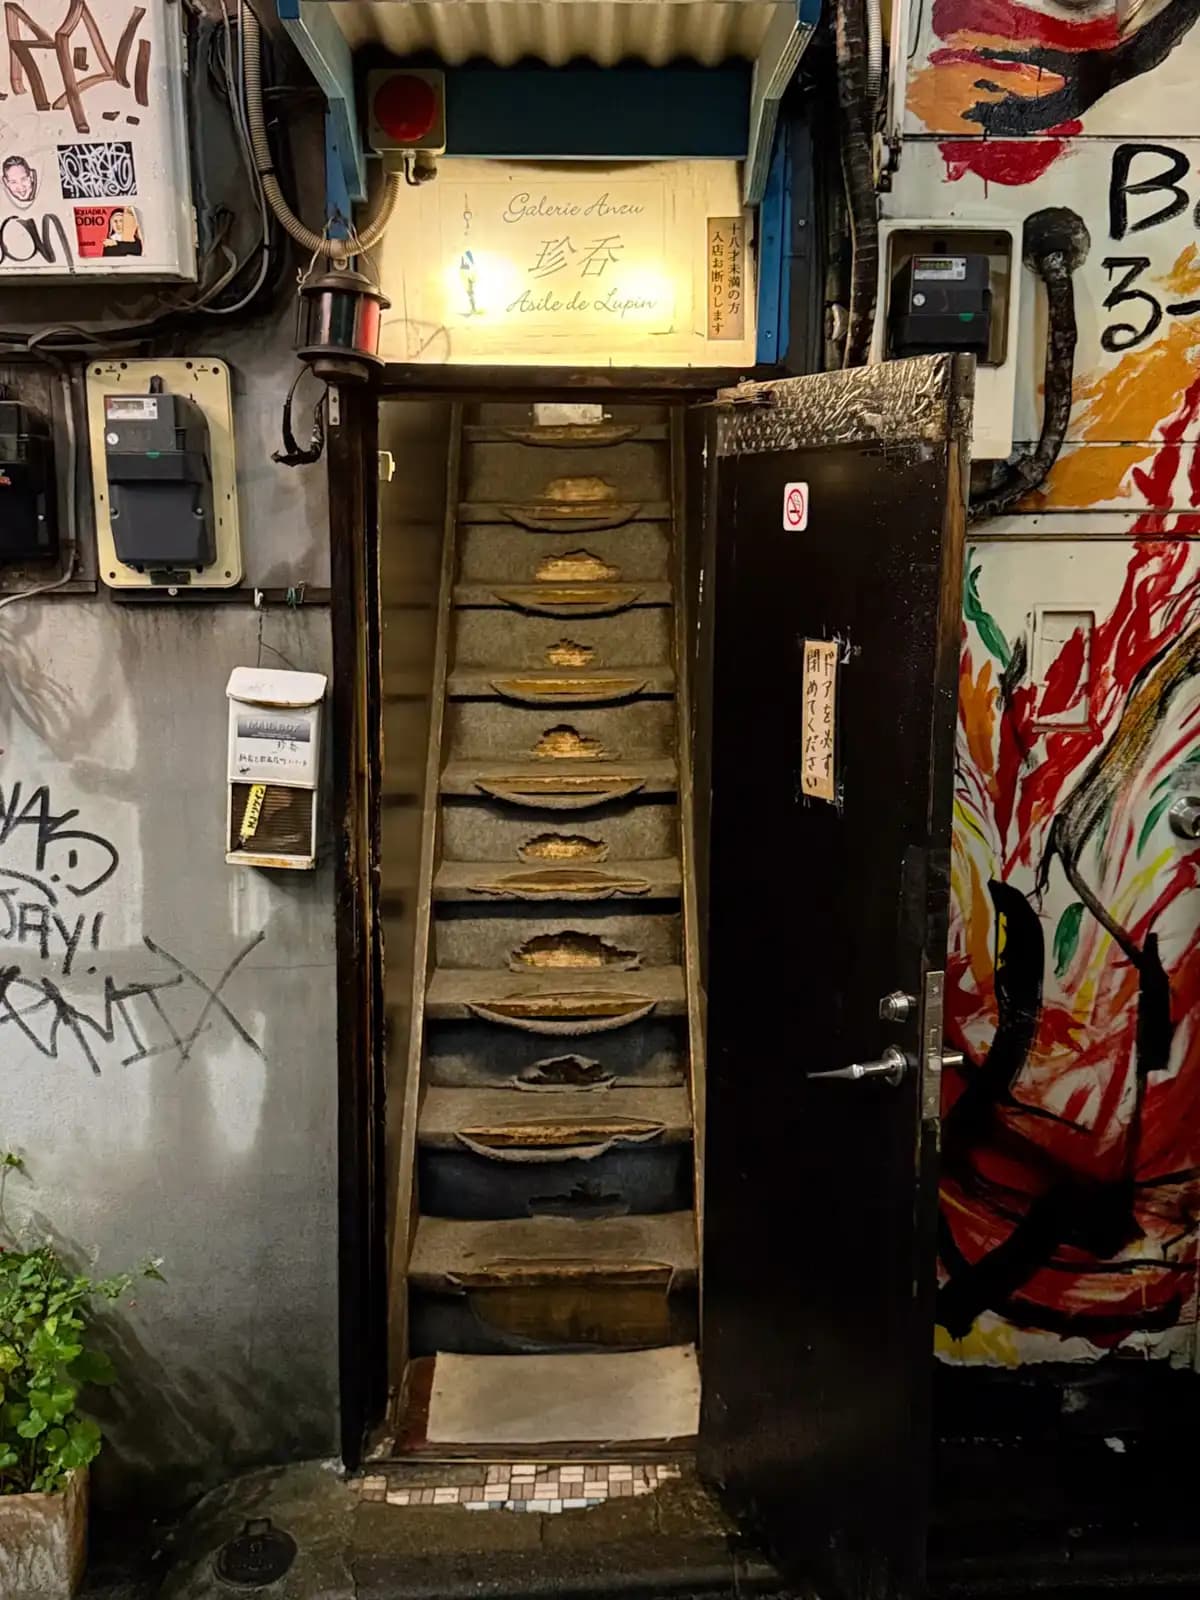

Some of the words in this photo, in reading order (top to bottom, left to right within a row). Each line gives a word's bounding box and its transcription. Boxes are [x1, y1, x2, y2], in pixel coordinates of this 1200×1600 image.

[75, 215, 105, 227] ODIO
[502, 192, 581, 223] Galerie
[584, 192, 645, 217] Anzu
[527, 235, 625, 280] 珍呑
[711, 231, 725, 335] 入店お断りします
[728, 222, 741, 315] 十八才未満の方
[506, 289, 561, 313] Asile
[566, 291, 590, 311] de
[594, 287, 657, 319] Lupin
[805, 648, 820, 789] 閉めてください
[820, 650, 834, 778] ドアを必ず
